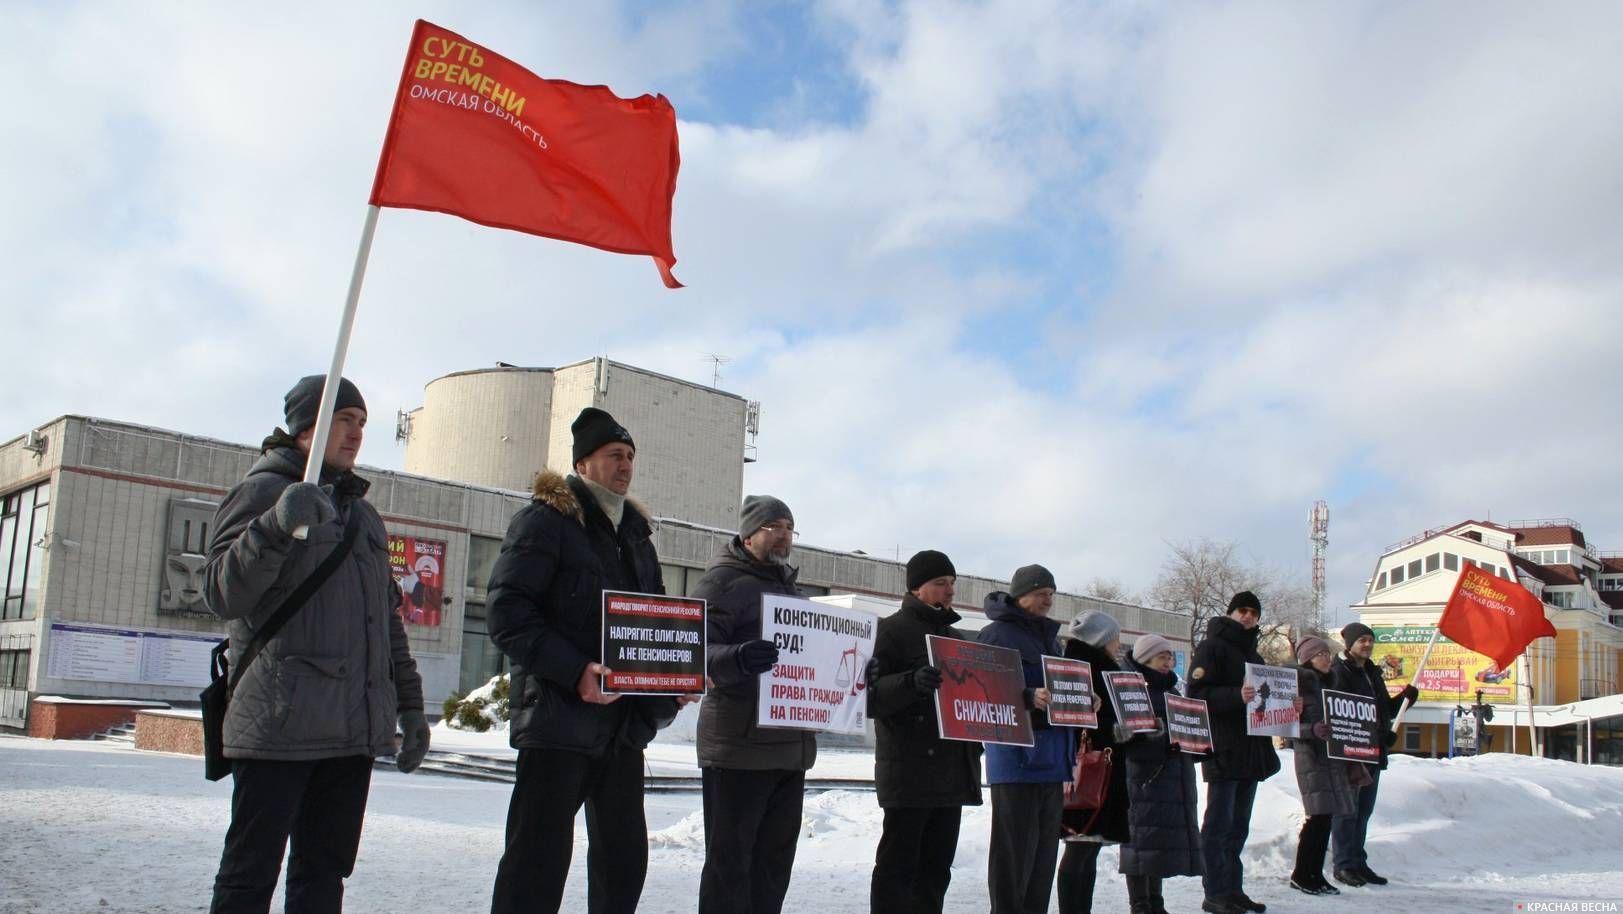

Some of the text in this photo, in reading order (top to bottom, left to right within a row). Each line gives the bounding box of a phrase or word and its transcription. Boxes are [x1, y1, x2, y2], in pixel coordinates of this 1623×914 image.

[422, 36, 484, 68] СУТЬ
[414, 58, 527, 117] ВРЕМЕНИ
[410, 84, 548, 150] ОМСКАЯ ОБЛАСТЬ
[1467, 570, 1490, 586] СУТЬ
[1462, 579, 1508, 602] ВРЕМЕНИ
[1459, 589, 1516, 616] ОМСКАЯ ОБЛАСТЬ
[773, 607, 872, 640] КОНСТИТУЦИОННЫЙ
[610, 626, 701, 646] НАПРЯГИТЕ ОЛИГАРХОВ,
[773, 632, 804, 654] СУД!
[1378, 634, 1446, 642] Семейня
[619, 646, 692, 663] А НЕ ПЕНСИОНЕРОВ!
[772, 664, 815, 682] ЗАЩИТИ
[1423, 670, 1460, 679] ПОДАРКИ
[771, 684, 845, 707] ПРАВА ГРАЖДАН
[1426, 680, 1441, 690] 2,5
[770, 705, 831, 724] НА ПЕНСИЮ!
[954, 699, 1018, 726] СНИЖЕНИЕ
